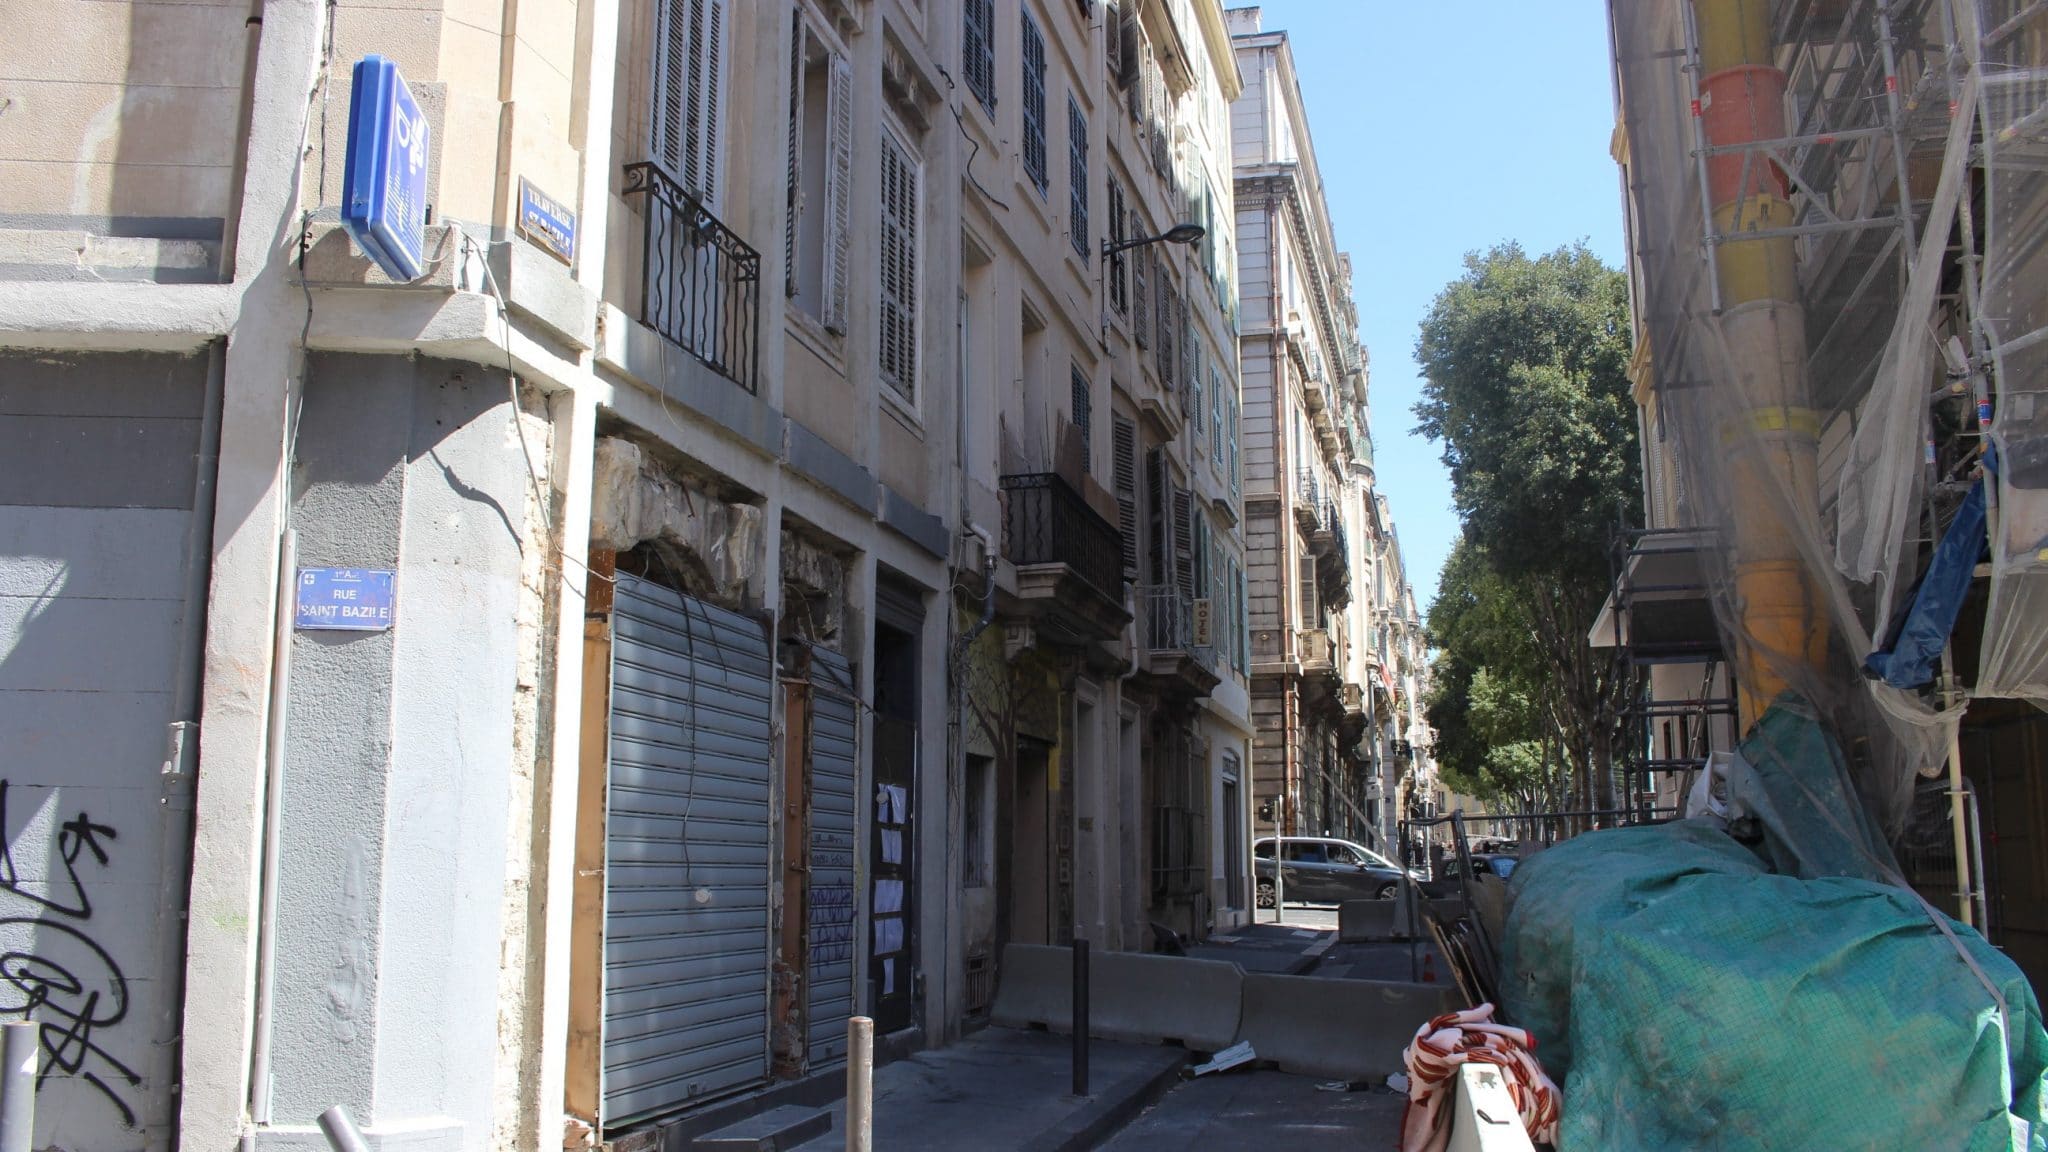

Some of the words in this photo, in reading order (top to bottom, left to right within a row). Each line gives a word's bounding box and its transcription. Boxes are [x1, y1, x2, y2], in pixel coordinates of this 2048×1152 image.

[528, 187, 571, 230] TRAVERSE
[333, 589, 357, 600] RUE
[301, 605, 339, 616] SAINT
[1198, 602, 1208, 644] HOTEL
